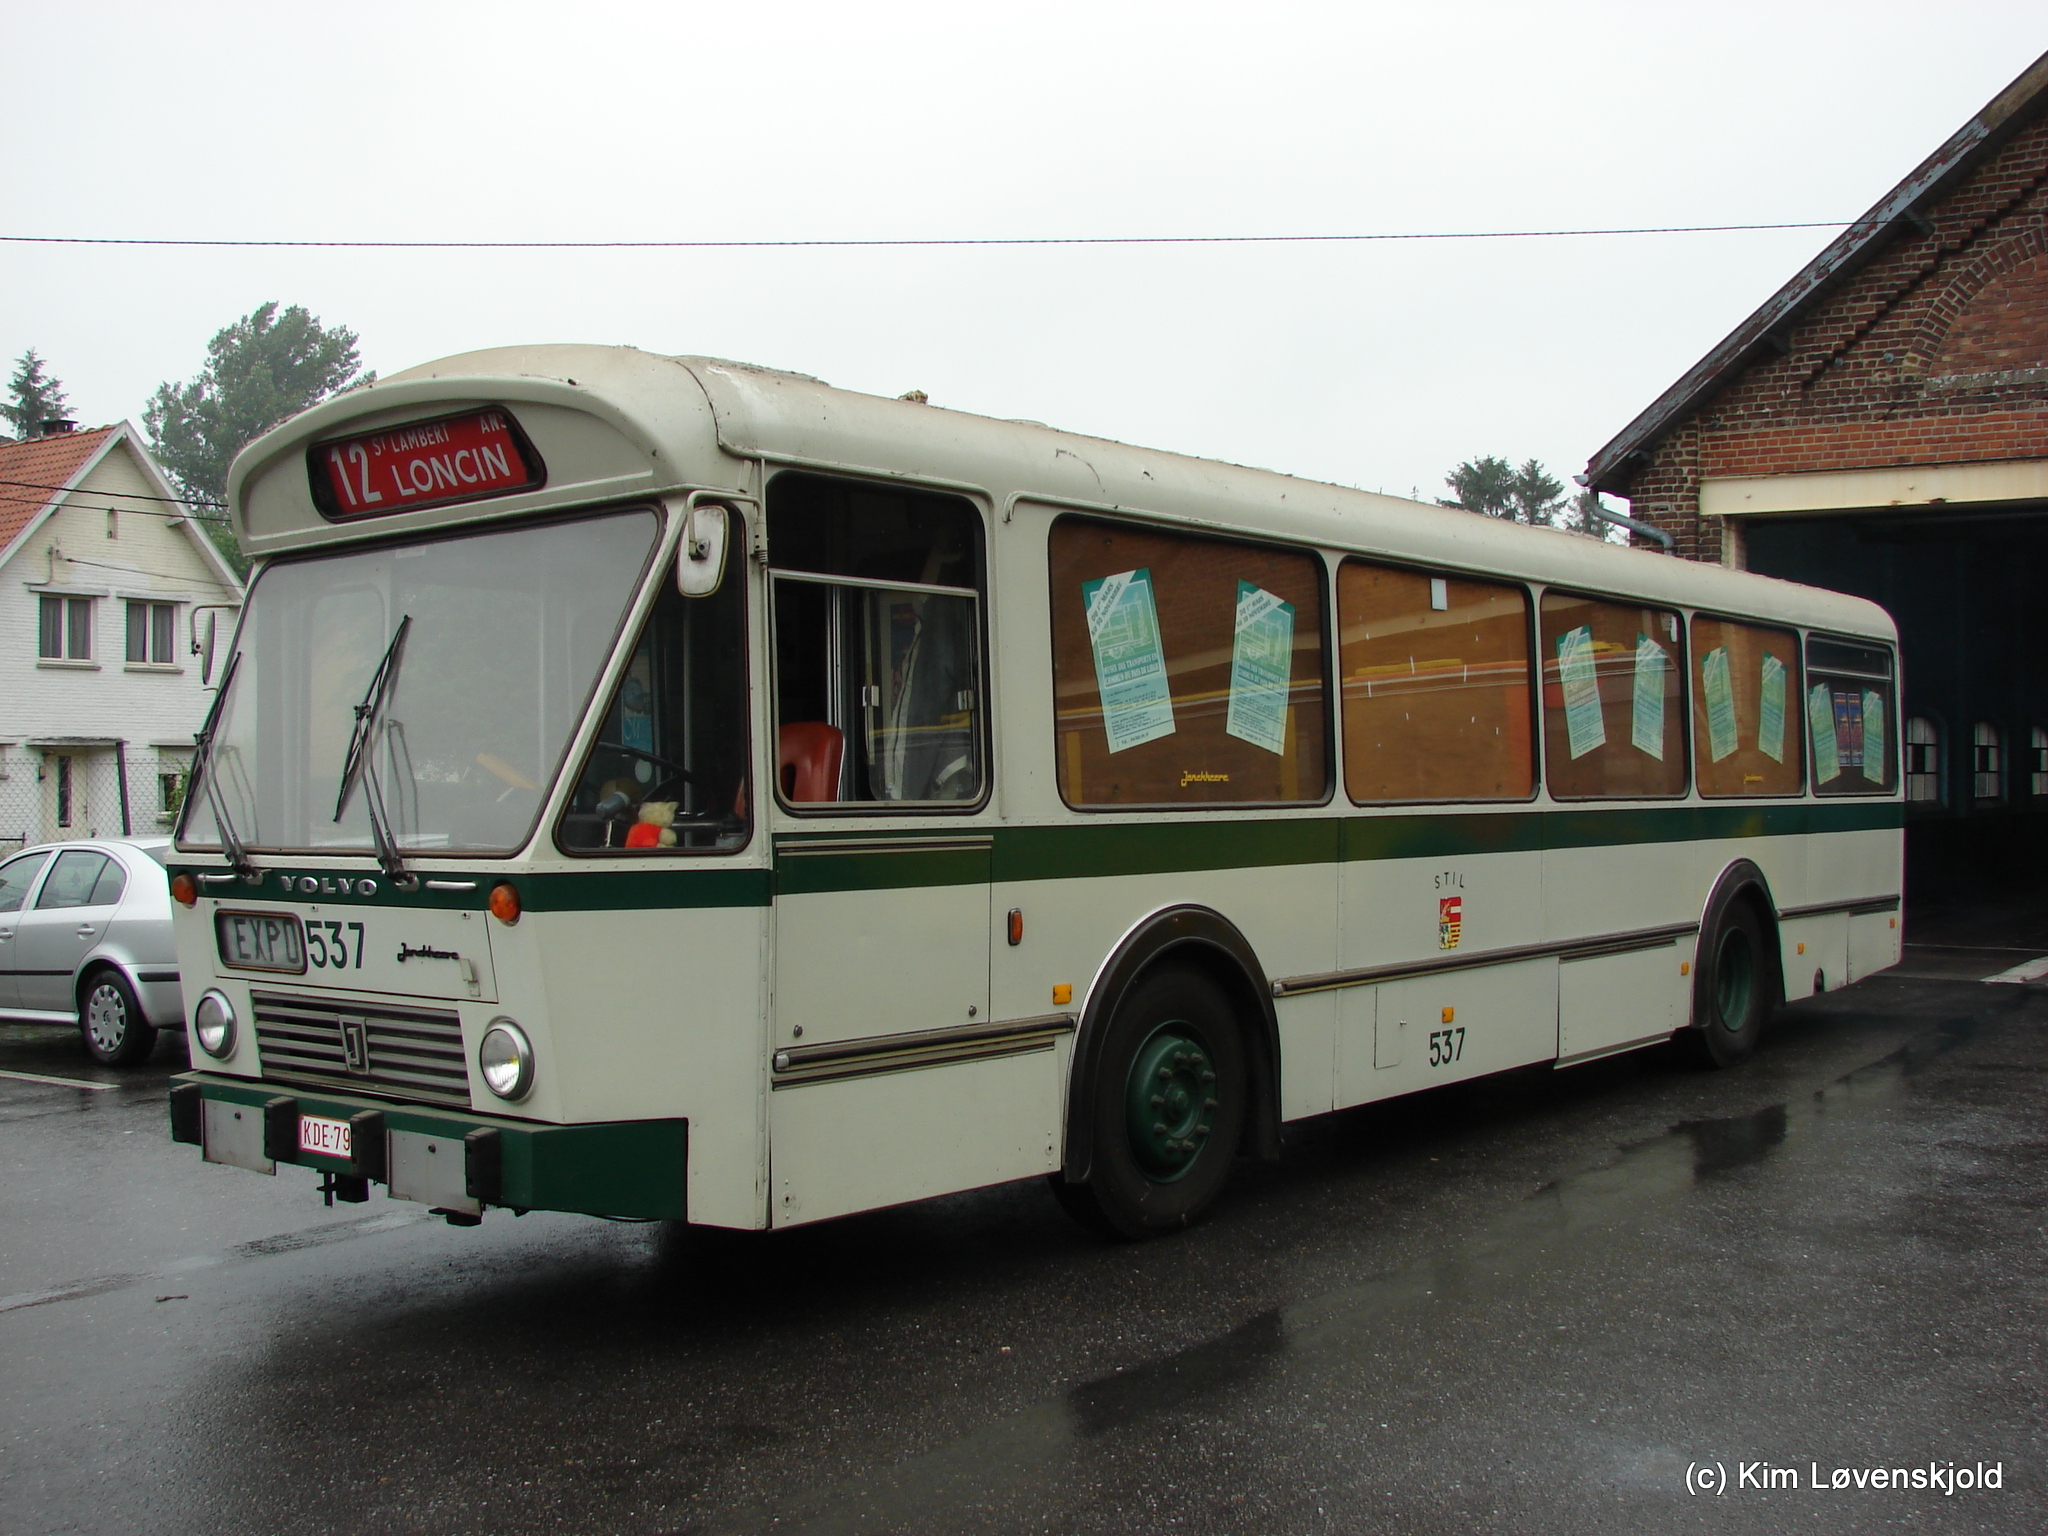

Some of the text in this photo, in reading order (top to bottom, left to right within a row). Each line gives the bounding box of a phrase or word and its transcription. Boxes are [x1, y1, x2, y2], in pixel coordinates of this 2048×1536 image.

[390, 423, 450, 452] LAMBERT
[331, 443, 511, 506] 12 LONCIN
[281, 875, 377, 896] VOLVO
[1434, 871, 1464, 889] STIL
[234, 918, 300, 964] EXPO
[305, 920, 364, 969] 537
[1429, 1027, 1466, 1067] 537
